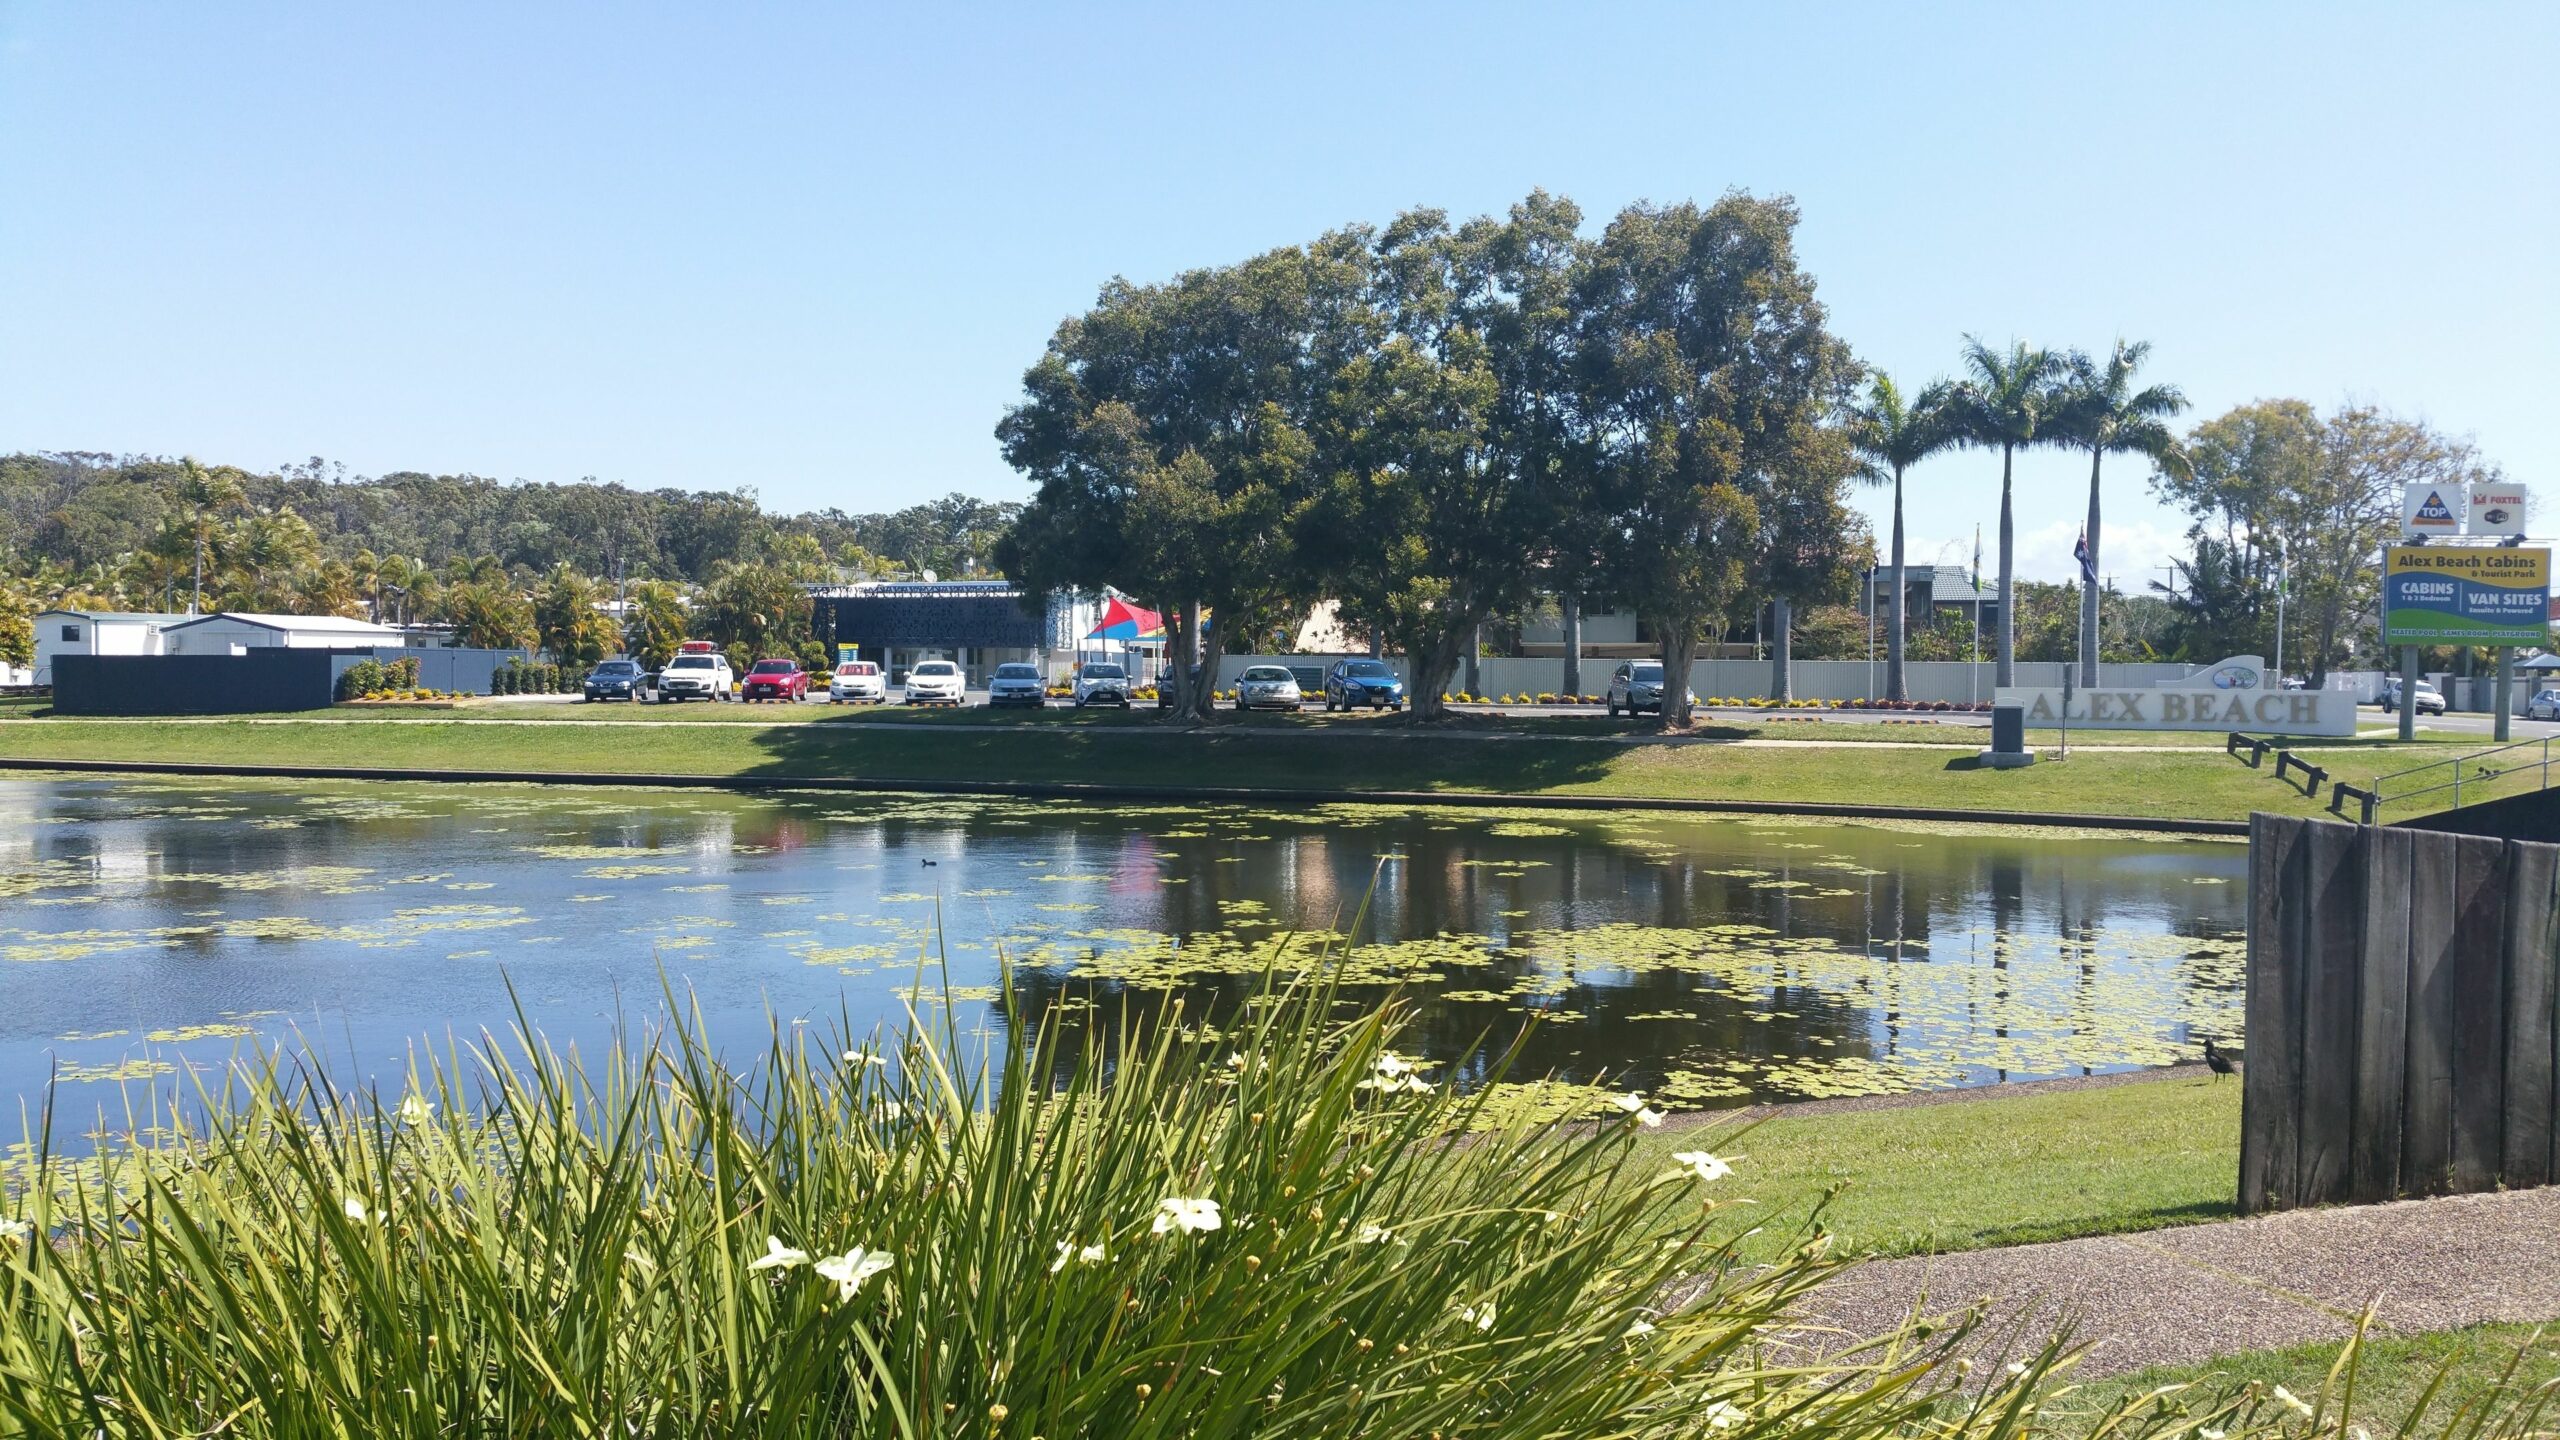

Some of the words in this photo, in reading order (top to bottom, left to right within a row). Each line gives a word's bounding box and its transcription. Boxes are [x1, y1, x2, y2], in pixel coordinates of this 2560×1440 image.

[2490, 496, 2522, 504] FOXTEL
[2421, 507, 2447, 517] TOP
[2398, 554, 2431, 567] Alex
[2436, 555, 2480, 568] Beach
[2486, 556, 2536, 568] Cabins
[2481, 570, 2512, 578] Tourist
[2514, 570, 2535, 578] Park
[2401, 582, 2454, 595] CABINS
[2468, 593, 2500, 605] VAN
[2503, 593, 2542, 606] SITES
[2418, 629, 2438, 637] POOL
[2442, 629, 2465, 637] GAMES
[2161, 693, 2320, 724] BEACH
